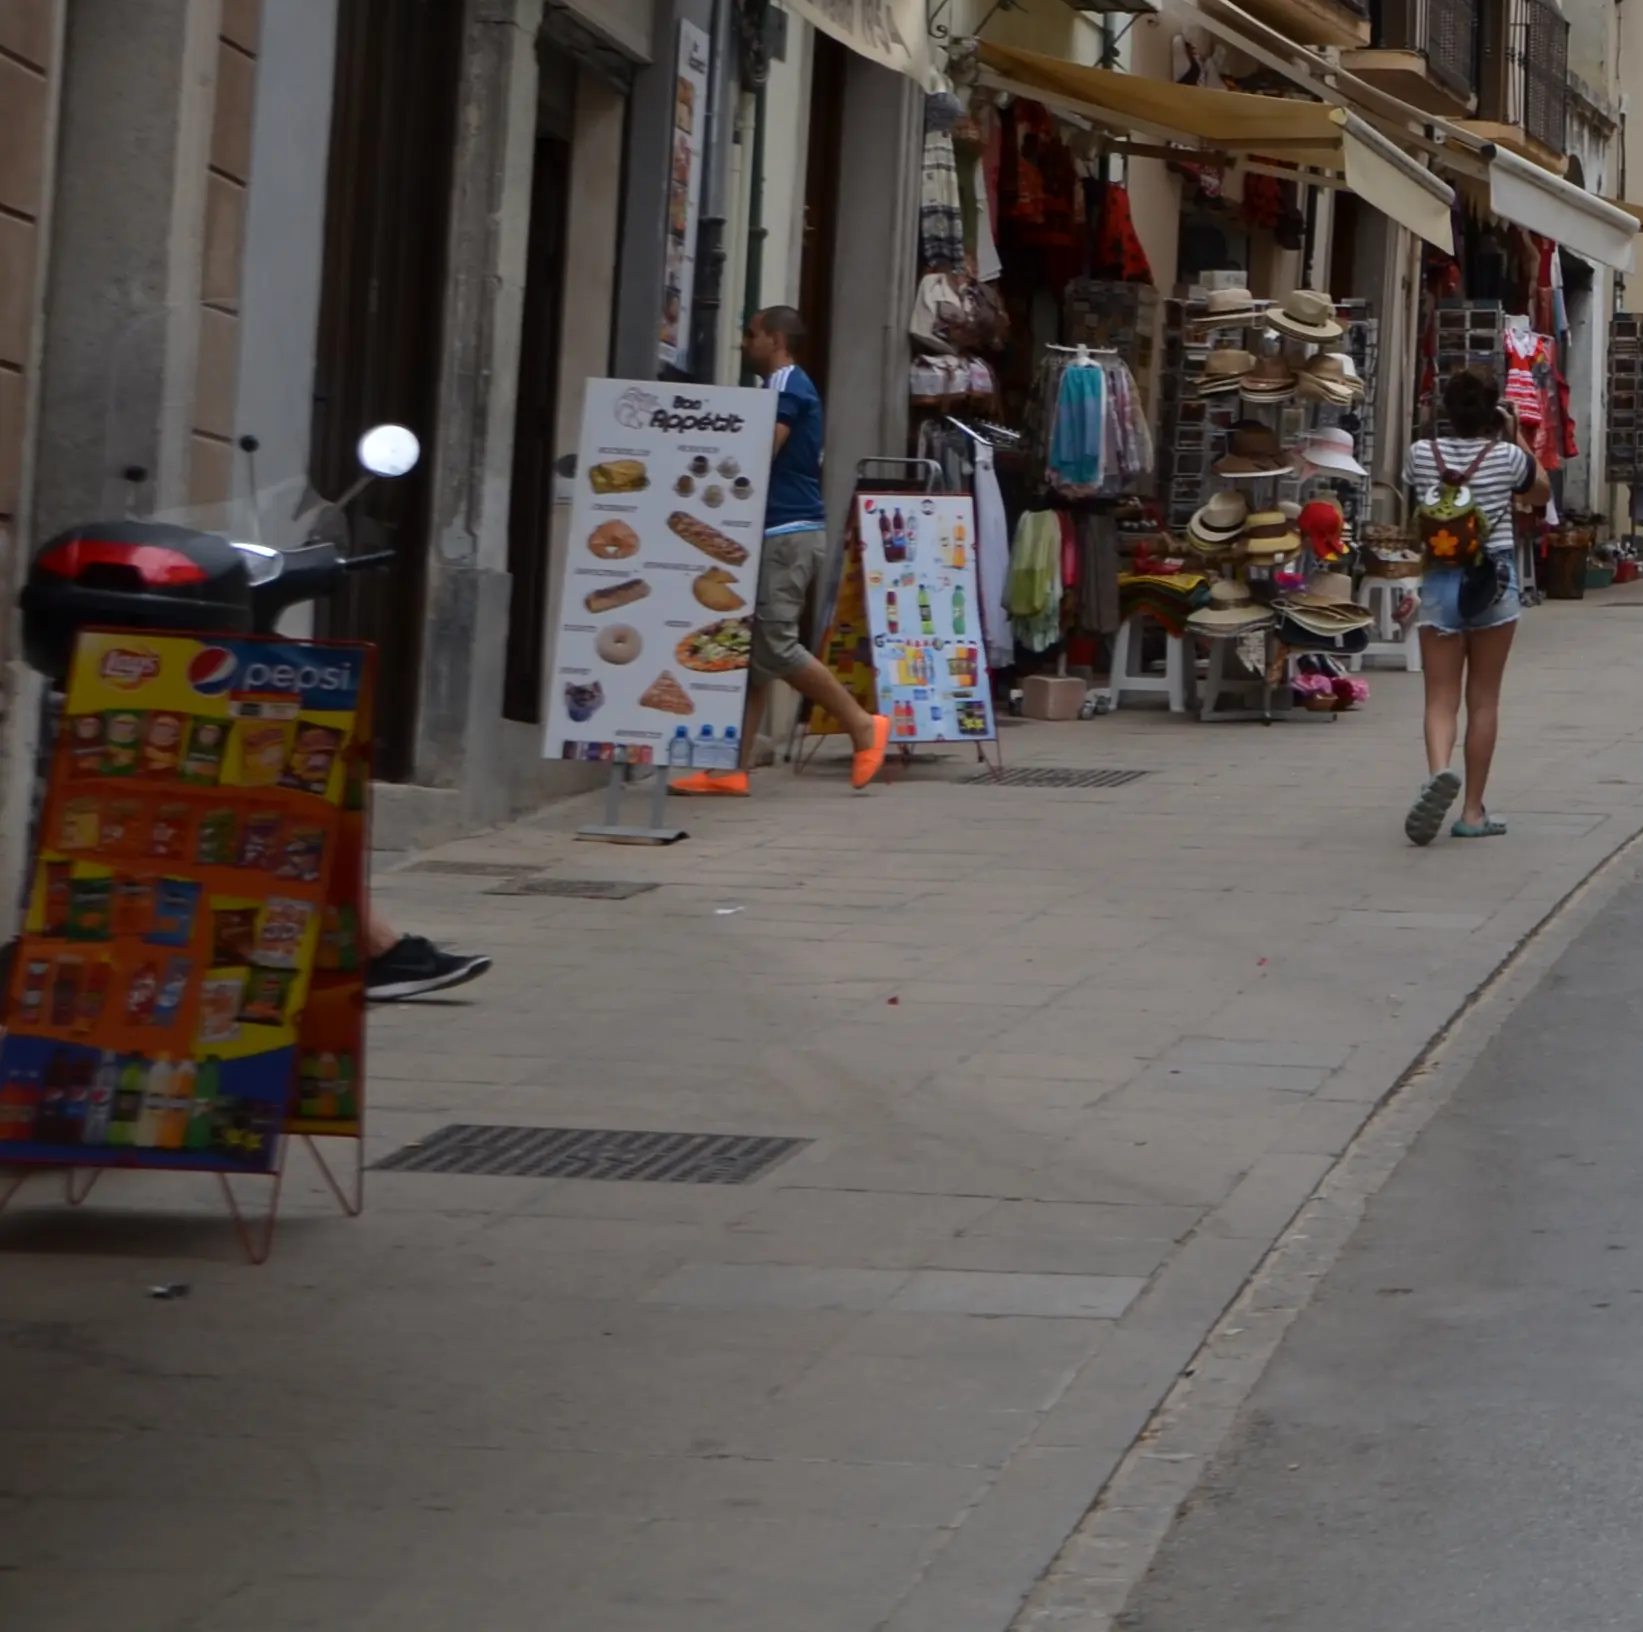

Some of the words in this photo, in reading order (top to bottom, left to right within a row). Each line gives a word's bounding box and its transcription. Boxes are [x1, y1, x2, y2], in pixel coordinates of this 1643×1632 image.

[672, 395, 703, 410] Bon
[650, 407, 746, 433] Appétit
[244, 662, 352, 692] pepsi
